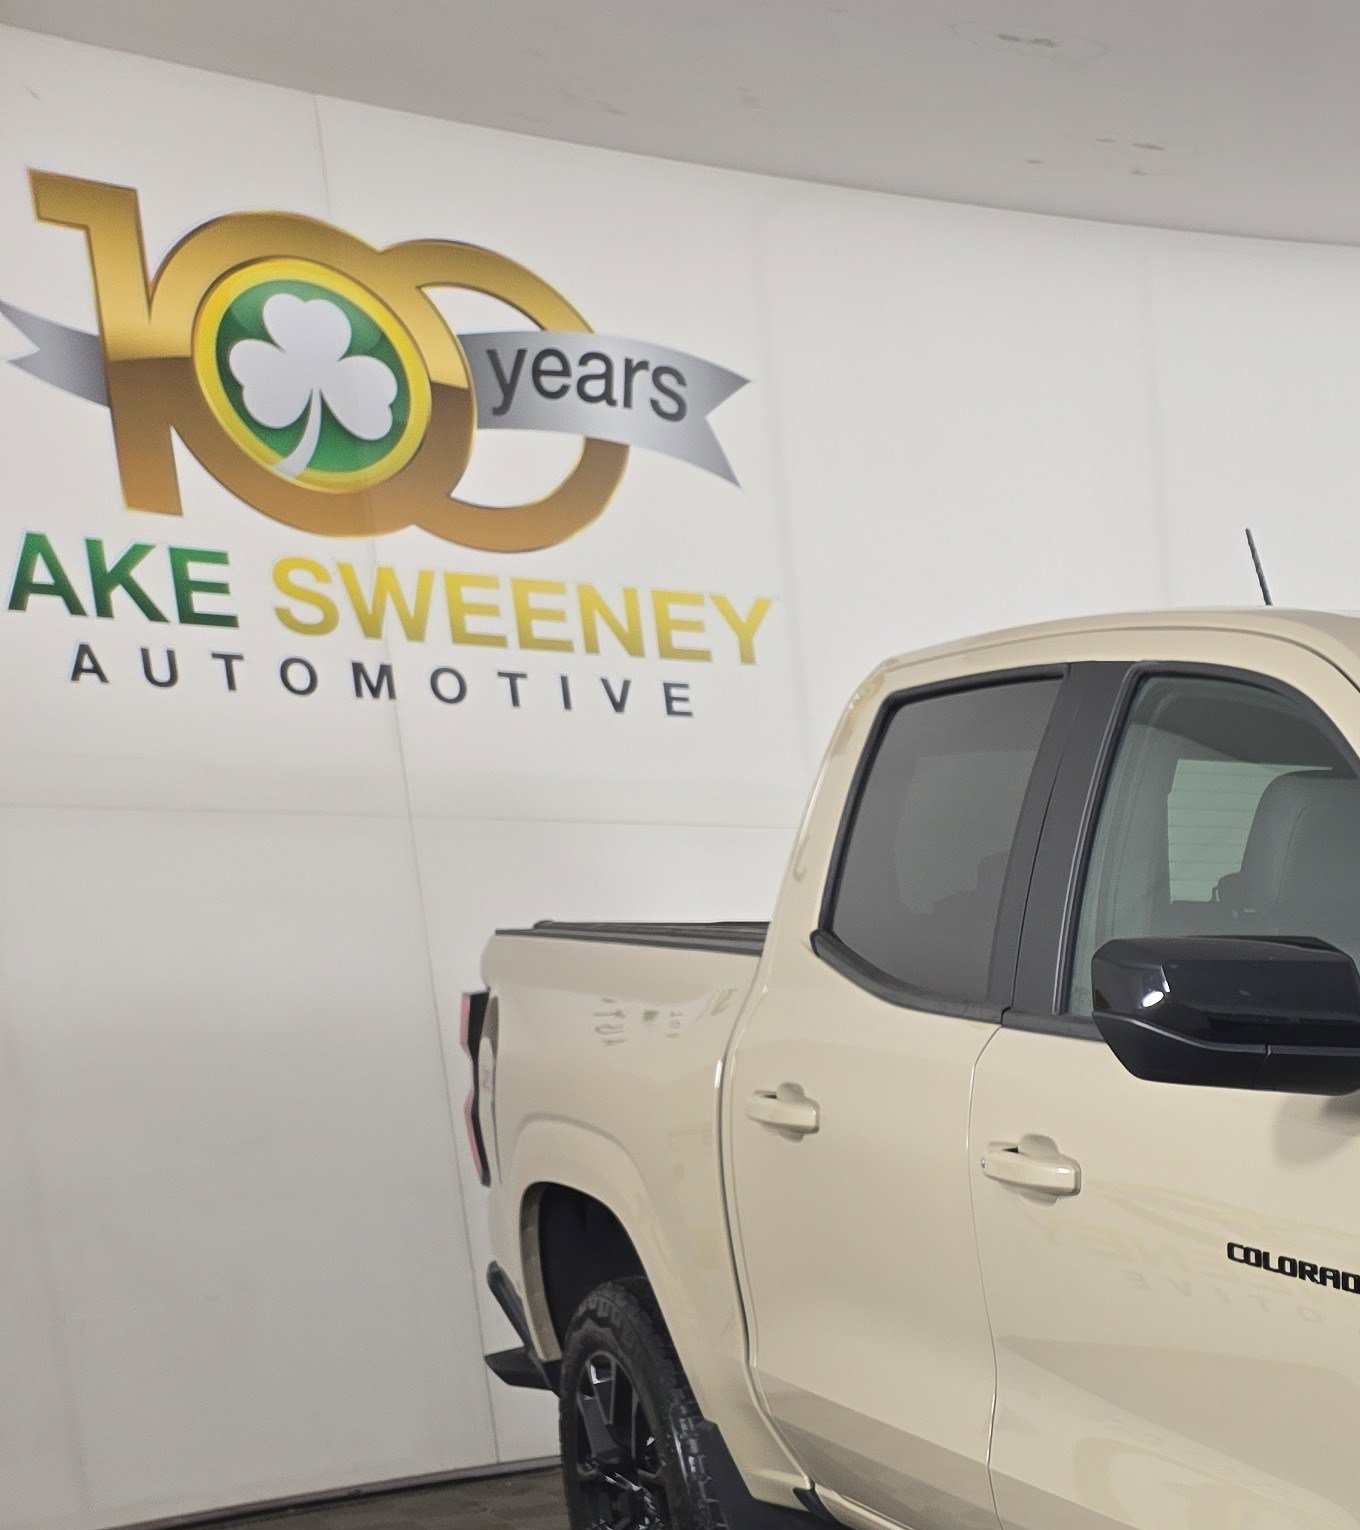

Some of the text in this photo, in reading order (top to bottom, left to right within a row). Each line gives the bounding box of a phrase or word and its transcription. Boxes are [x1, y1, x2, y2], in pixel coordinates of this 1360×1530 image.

[485, 346, 687, 422] years
[8, 531, 773, 666] AKE SWEENEY
[70, 643, 694, 718] AUTOMOTIVE
